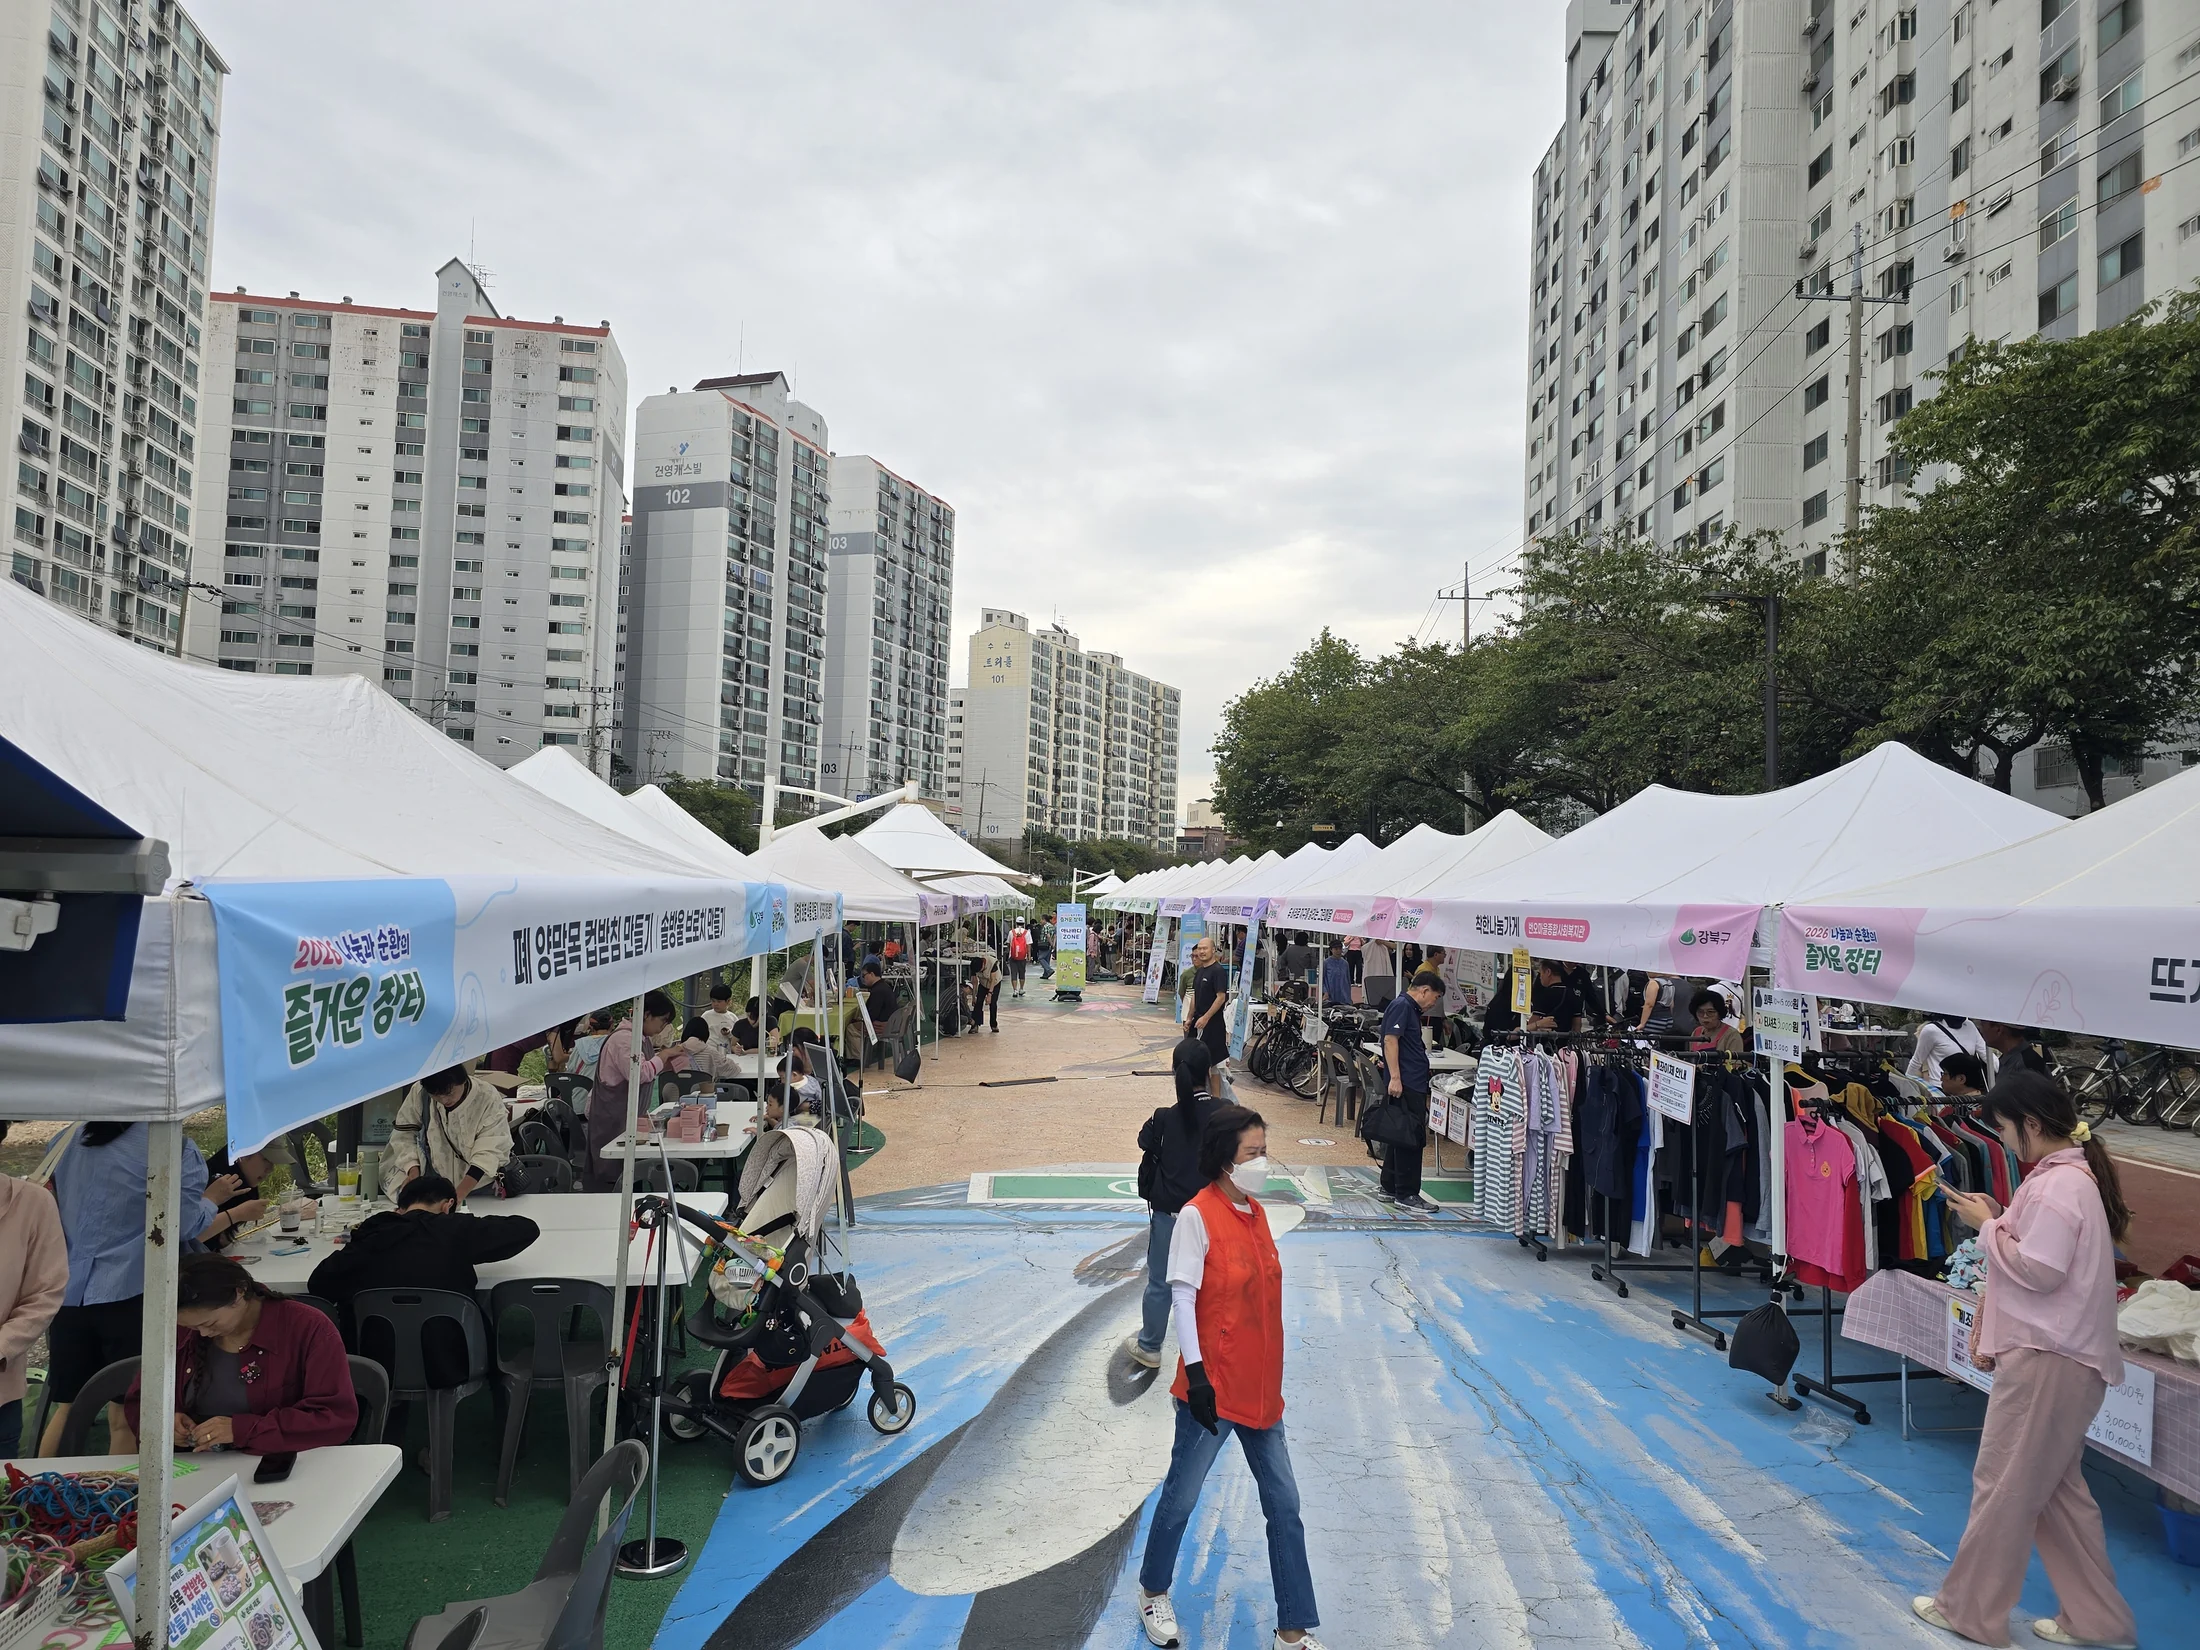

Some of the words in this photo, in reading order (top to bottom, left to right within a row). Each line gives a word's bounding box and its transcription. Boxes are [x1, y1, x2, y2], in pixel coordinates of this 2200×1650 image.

[655, 462, 702, 477] 건영캐스빌
[666, 489, 690, 504] 102
[991, 675, 1005, 684] 101
[986, 825, 999, 834] 101
[1475, 915, 1520, 937] 착한나눔가게
[1805, 927, 1829, 938] 2026
[1831, 927, 1853, 941] 나눔과
[1854, 927, 1877, 942] 순환의
[513, 927, 532, 985] 폐
[535, 921, 582, 981] 양말목
[585, 916, 621, 969] 컵받침
[623, 913, 654, 959] 만들기
[661, 909, 684, 950] 솔방울
[685, 908, 707, 944] 브로치
[707, 906, 726, 939] 만들기
[1698, 930, 1731, 945] 강북구
[294, 940, 343, 969] 2026
[335, 933, 375, 964] 나눔과
[377, 928, 410, 961] 순환의
[1805, 943, 1844, 972] 즐거운
[1845, 948, 1882, 975] 장터
[1764, 994, 1773, 1006] 외투
[1793, 998, 1799, 1010] 원
[284, 976, 371, 1065] 즐거운
[372, 971, 426, 1035] 장터
[1764, 1015, 1777, 1029] 티셔츠
[1793, 1021, 1799, 1033] 원
[1764, 1038, 1773, 1051] 바지
[1793, 1044, 1799, 1057] 원
[1656, 1059, 1675, 1076] 계좌이체
[1675, 1067, 1687, 1080] 안내
[1957, 1308, 1973, 1327] 계좌
[181, 1571, 208, 1601] 컵받침
[169, 1608, 195, 1643] 만들기
[192, 1591, 214, 1619] 체험
